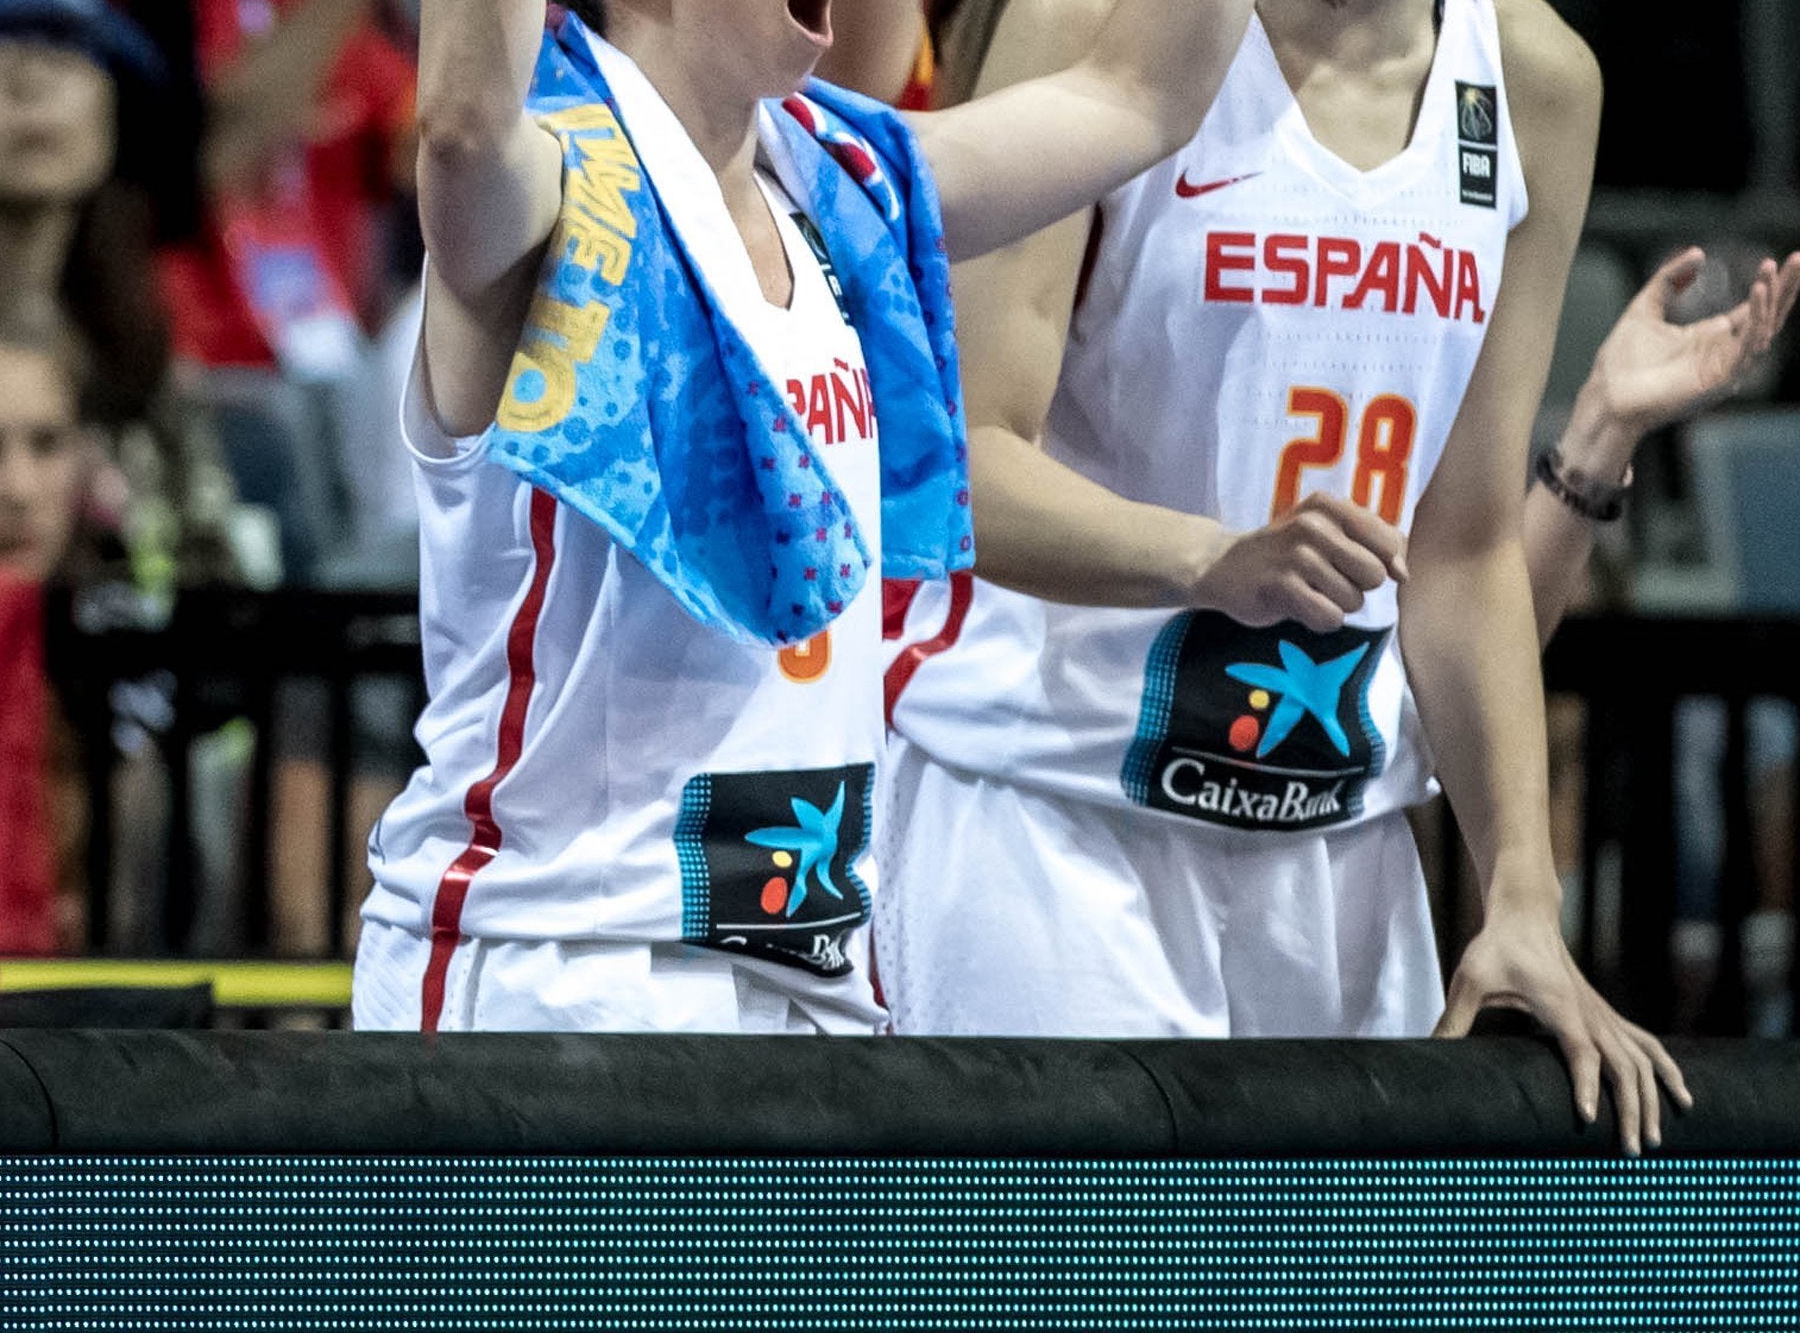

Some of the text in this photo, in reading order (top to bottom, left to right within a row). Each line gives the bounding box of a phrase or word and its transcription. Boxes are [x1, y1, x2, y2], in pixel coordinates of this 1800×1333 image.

[1461, 151, 1491, 178] FIBA
[1203, 231, 1486, 325] ESPAÑA
[1268, 385, 1418, 529] 28
